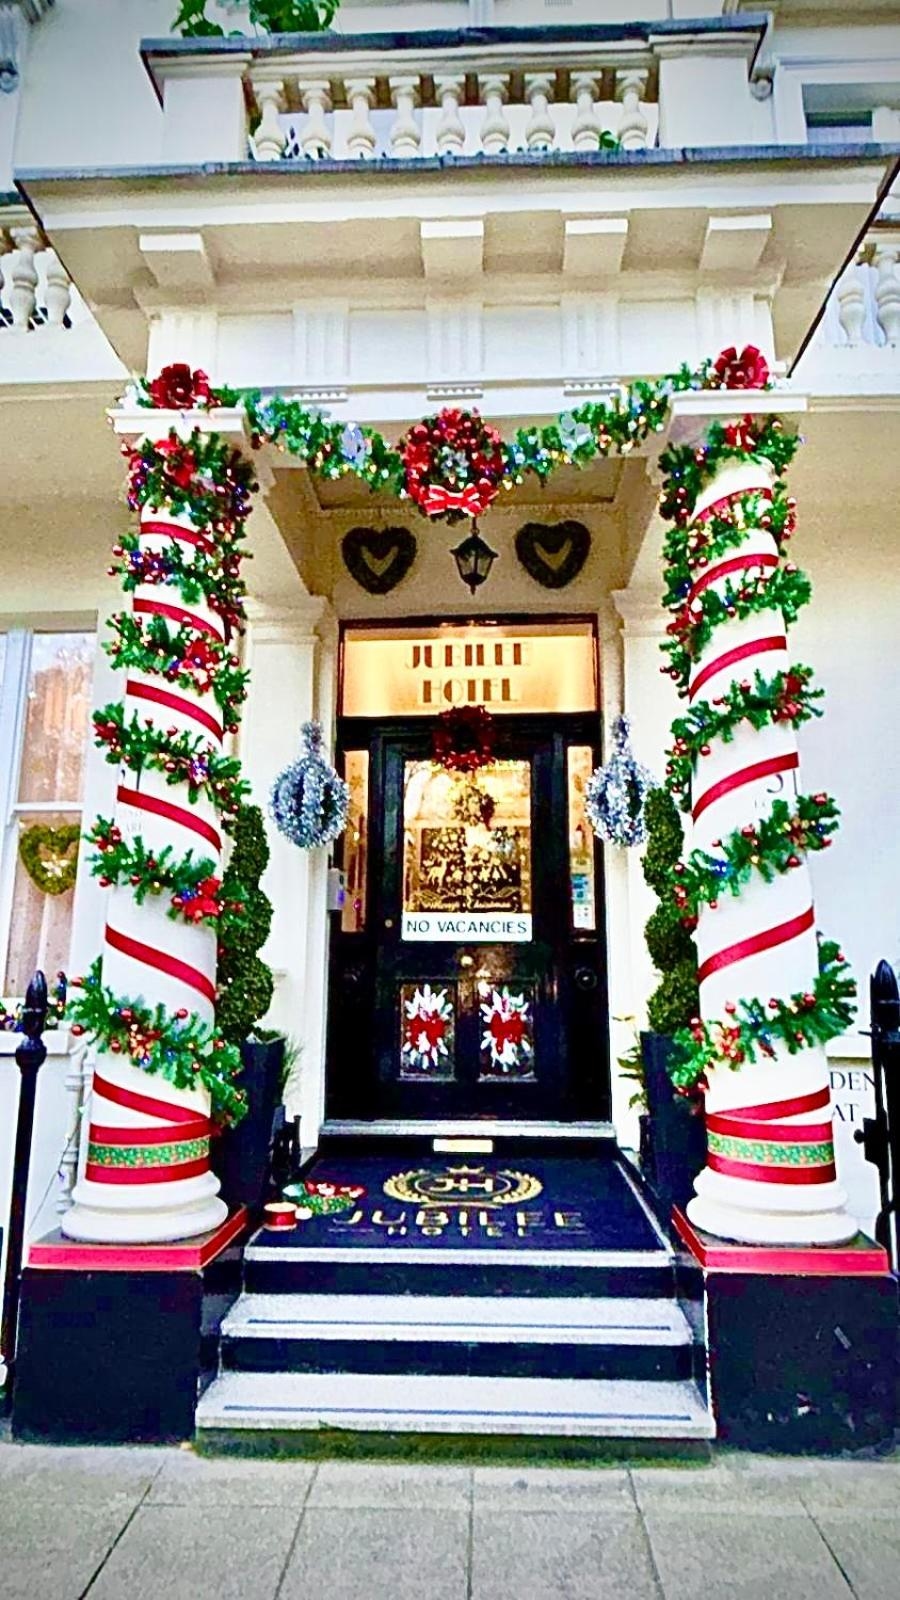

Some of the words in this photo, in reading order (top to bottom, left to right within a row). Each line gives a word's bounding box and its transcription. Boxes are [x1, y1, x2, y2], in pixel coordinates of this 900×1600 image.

[422, 678, 519, 704] HOTEL
[406, 919, 430, 933] NO
[437, 920, 527, 934] VACANCIES
[429, 1178, 494, 1192] JH
[333, 1210, 585, 1227] JUBILEE
[387, 1226, 532, 1237] HOTEL
